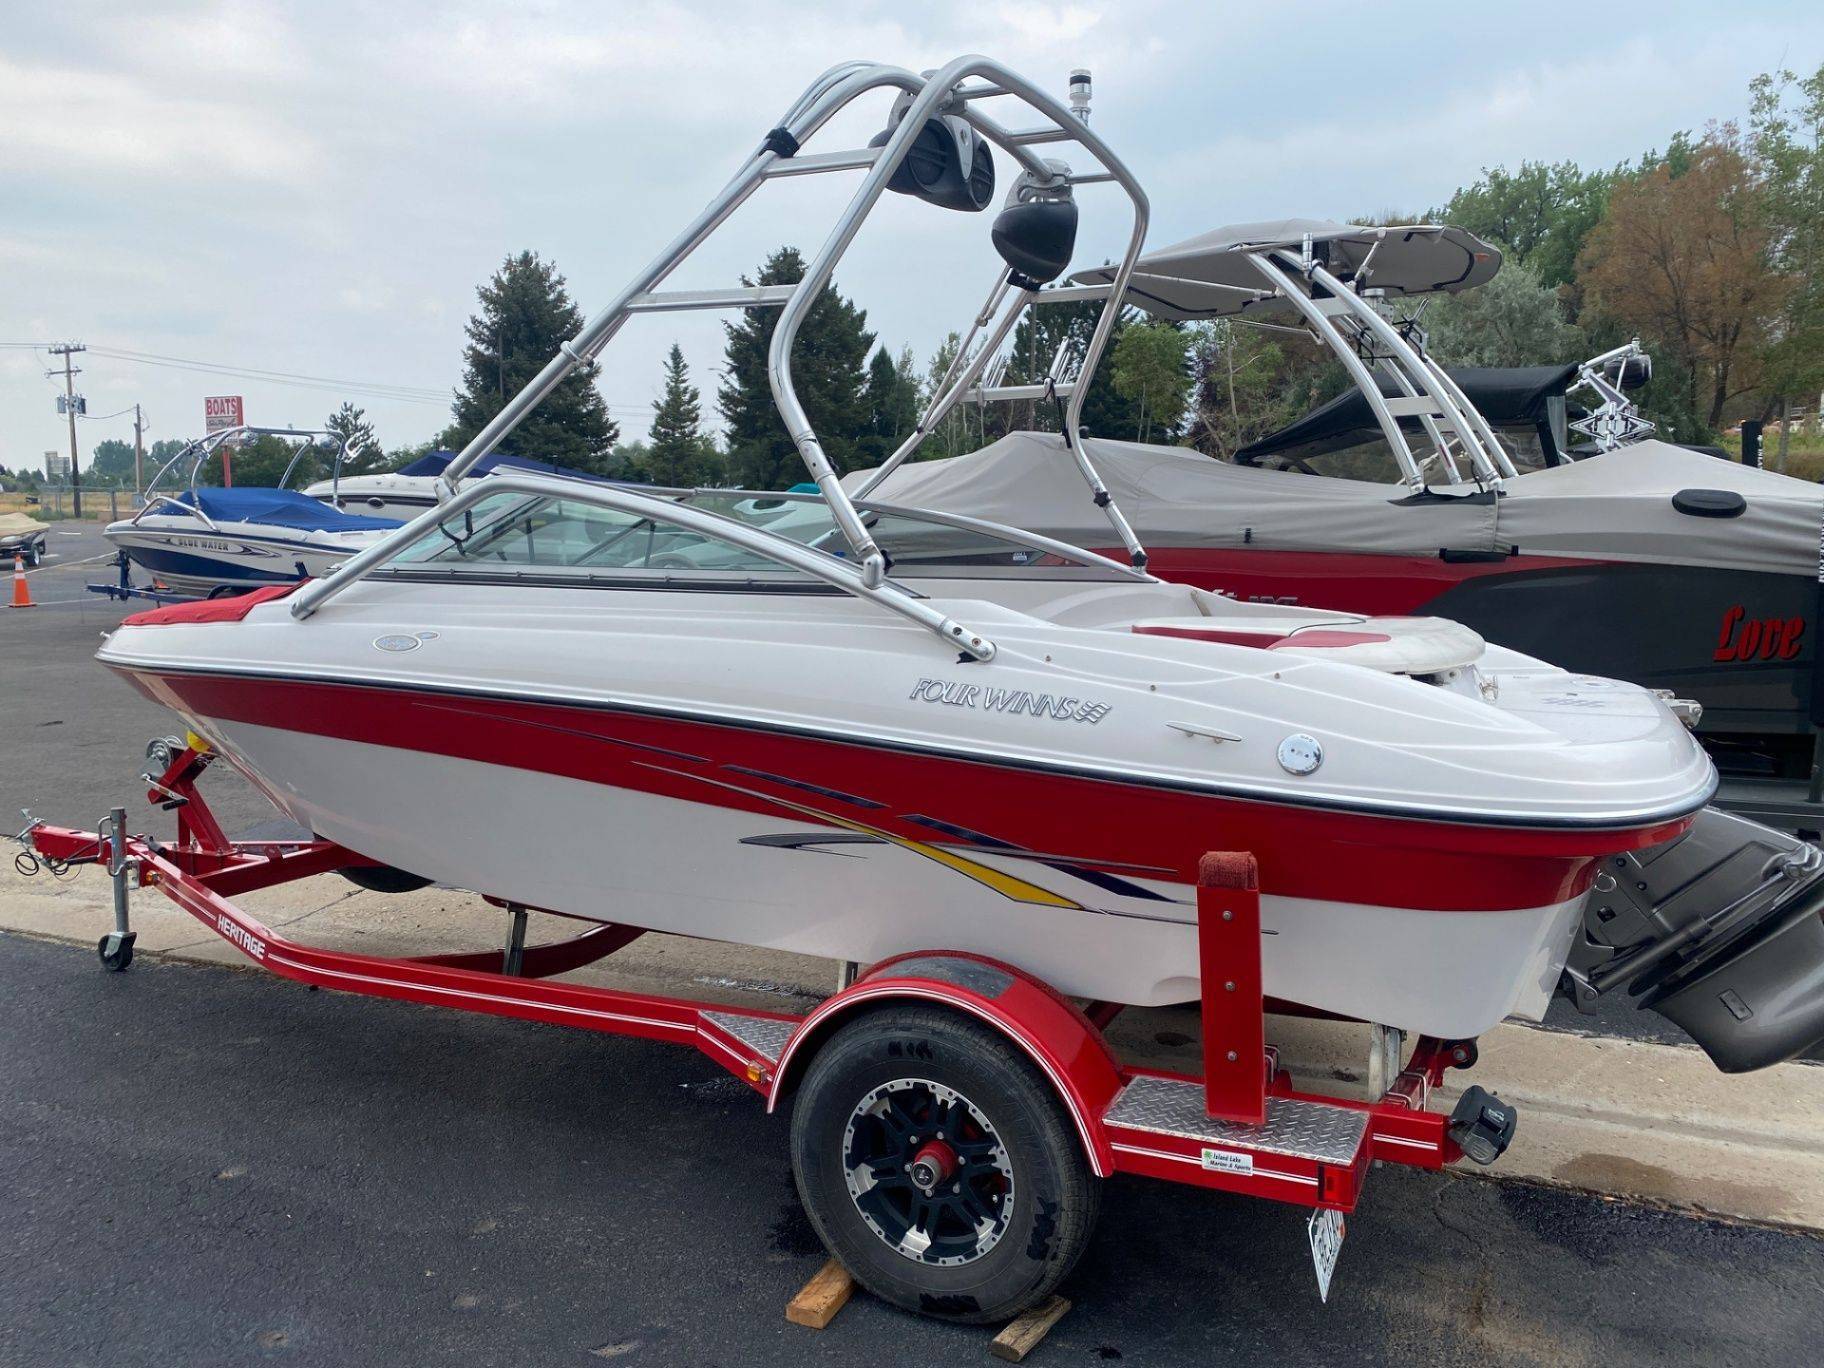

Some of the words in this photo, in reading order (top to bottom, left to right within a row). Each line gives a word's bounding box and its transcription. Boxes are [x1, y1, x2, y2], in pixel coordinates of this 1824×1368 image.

[206, 399, 237, 415] BOATS
[179, 538, 199, 548] BLUE
[201, 540, 229, 551] WATER
[1712, 603, 1805, 662] Love
[909, 677, 980, 707] FOUR
[983, 687, 1078, 721] WINNS
[217, 914, 266, 960] HERITAGE
[1213, 1152, 1229, 1161] Island
[1229, 1155, 1241, 1163] Lake
